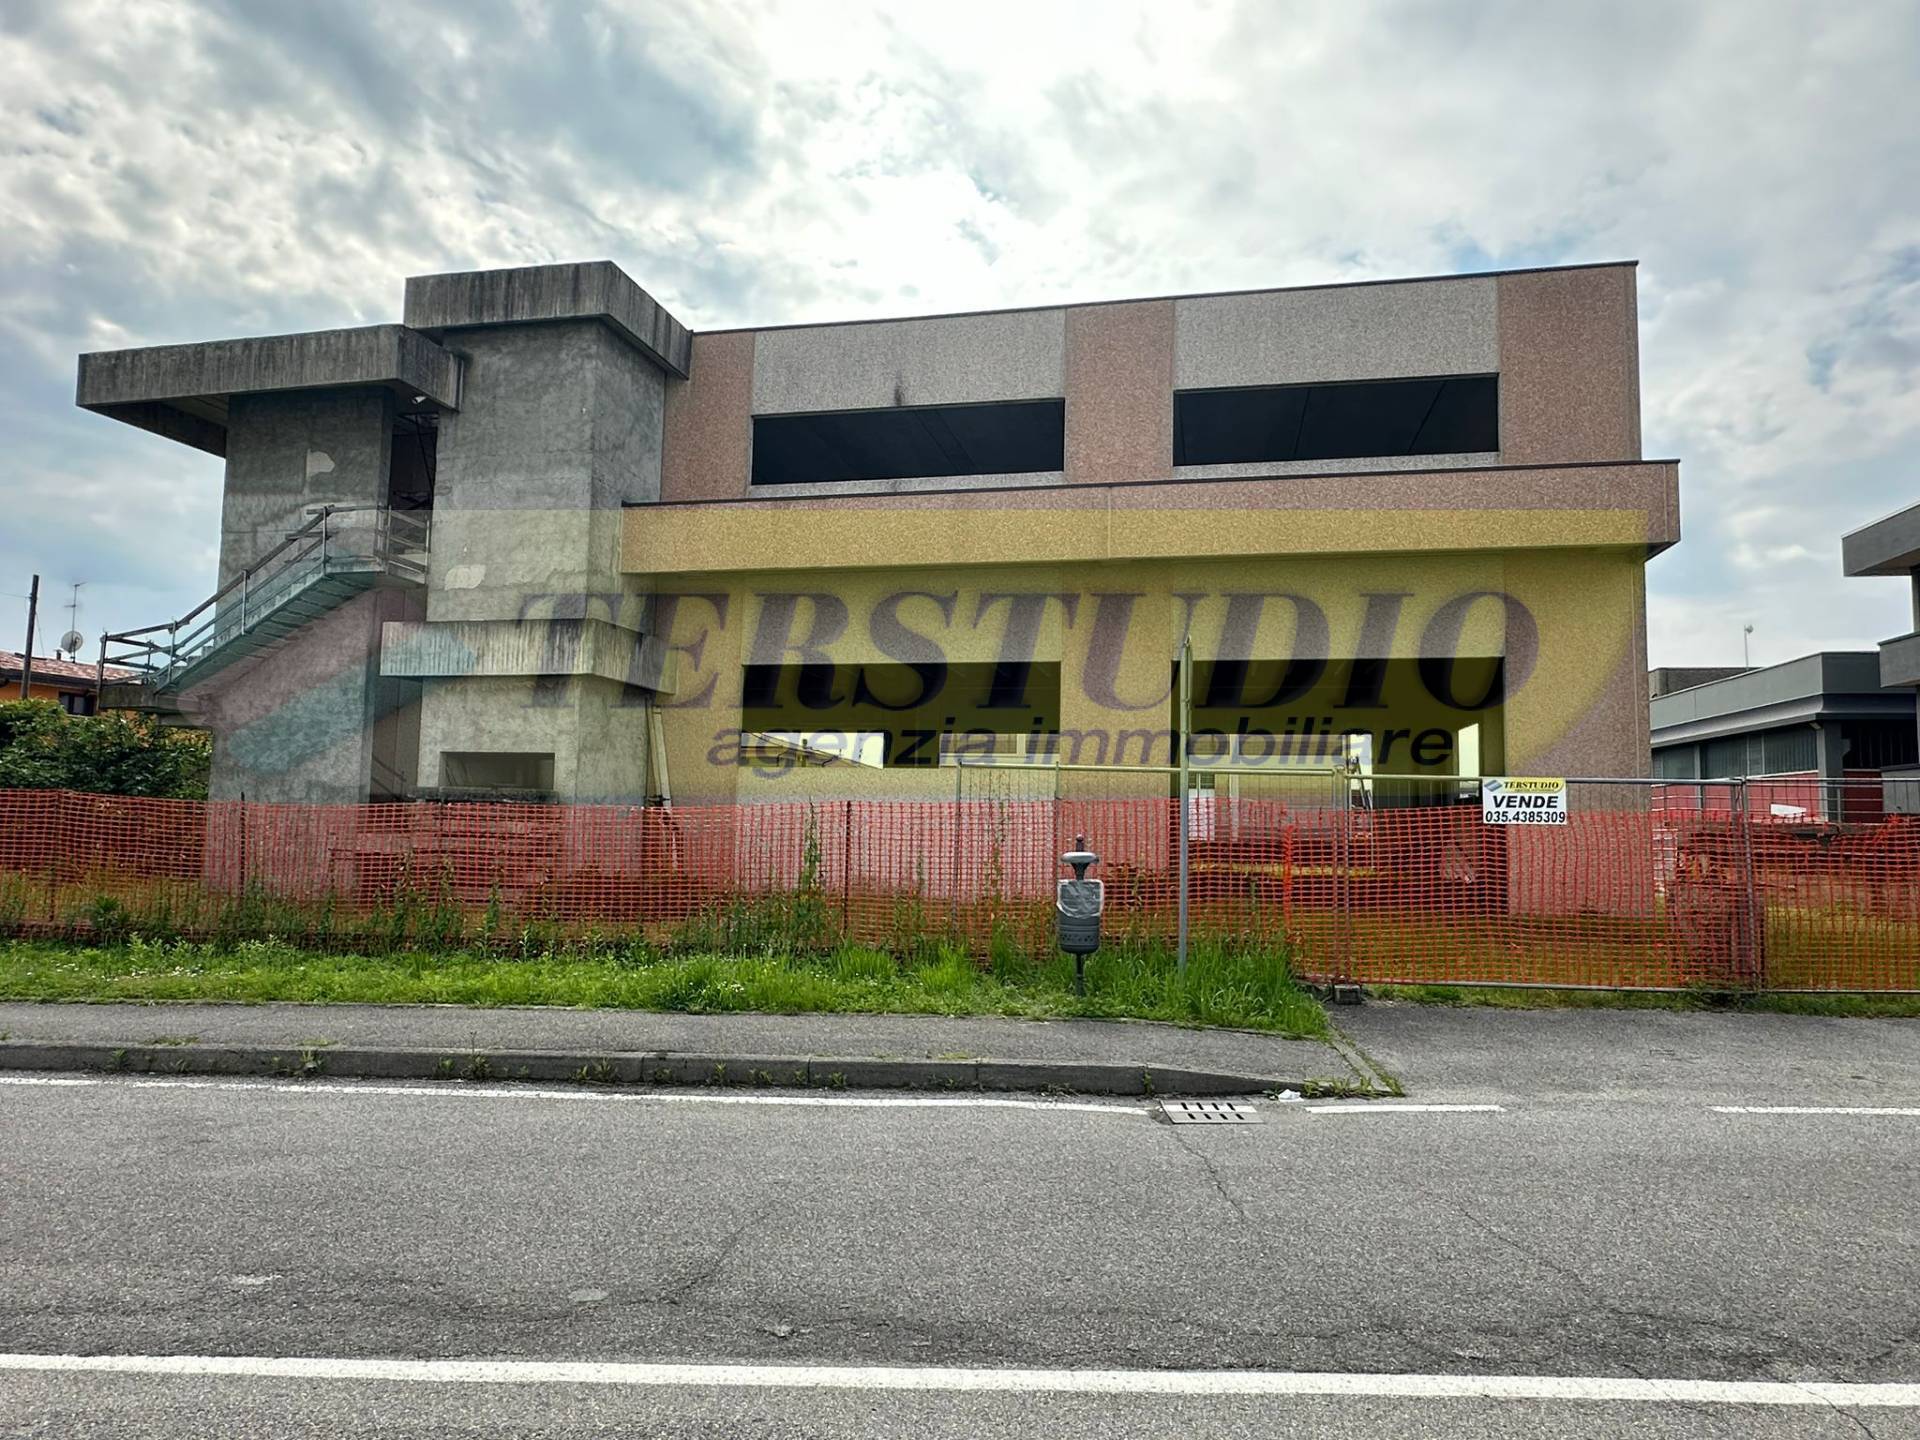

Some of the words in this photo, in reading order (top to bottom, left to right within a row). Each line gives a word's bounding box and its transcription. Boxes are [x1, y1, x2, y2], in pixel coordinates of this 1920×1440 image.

[1504, 781, 1559, 789] TERSTUDIO
[1493, 795, 1559, 808] VENDE
[1485, 811, 1566, 823] 035.4385309
